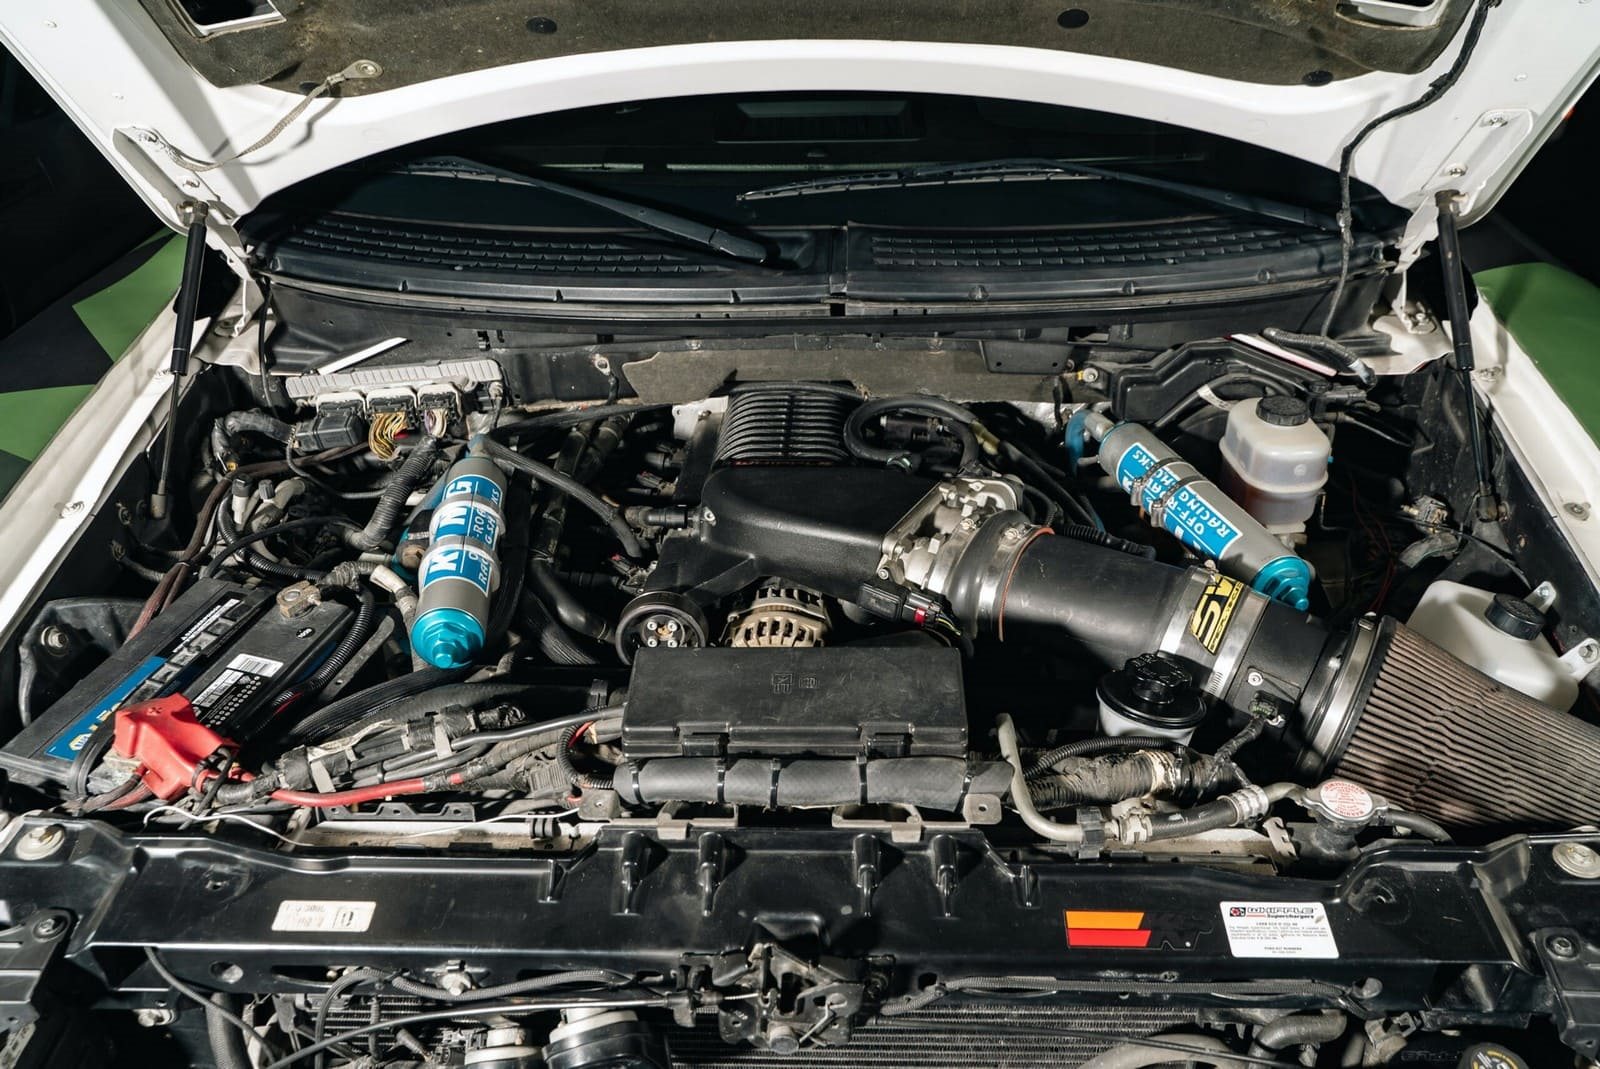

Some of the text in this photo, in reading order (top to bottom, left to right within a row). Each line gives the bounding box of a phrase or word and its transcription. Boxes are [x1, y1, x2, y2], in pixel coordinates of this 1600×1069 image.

[427, 481, 473, 574] KNG
[469, 508, 488, 561] O-ROA
[478, 488, 500, 585] RACG SHKS
[1178, 490, 1230, 538] RACING
